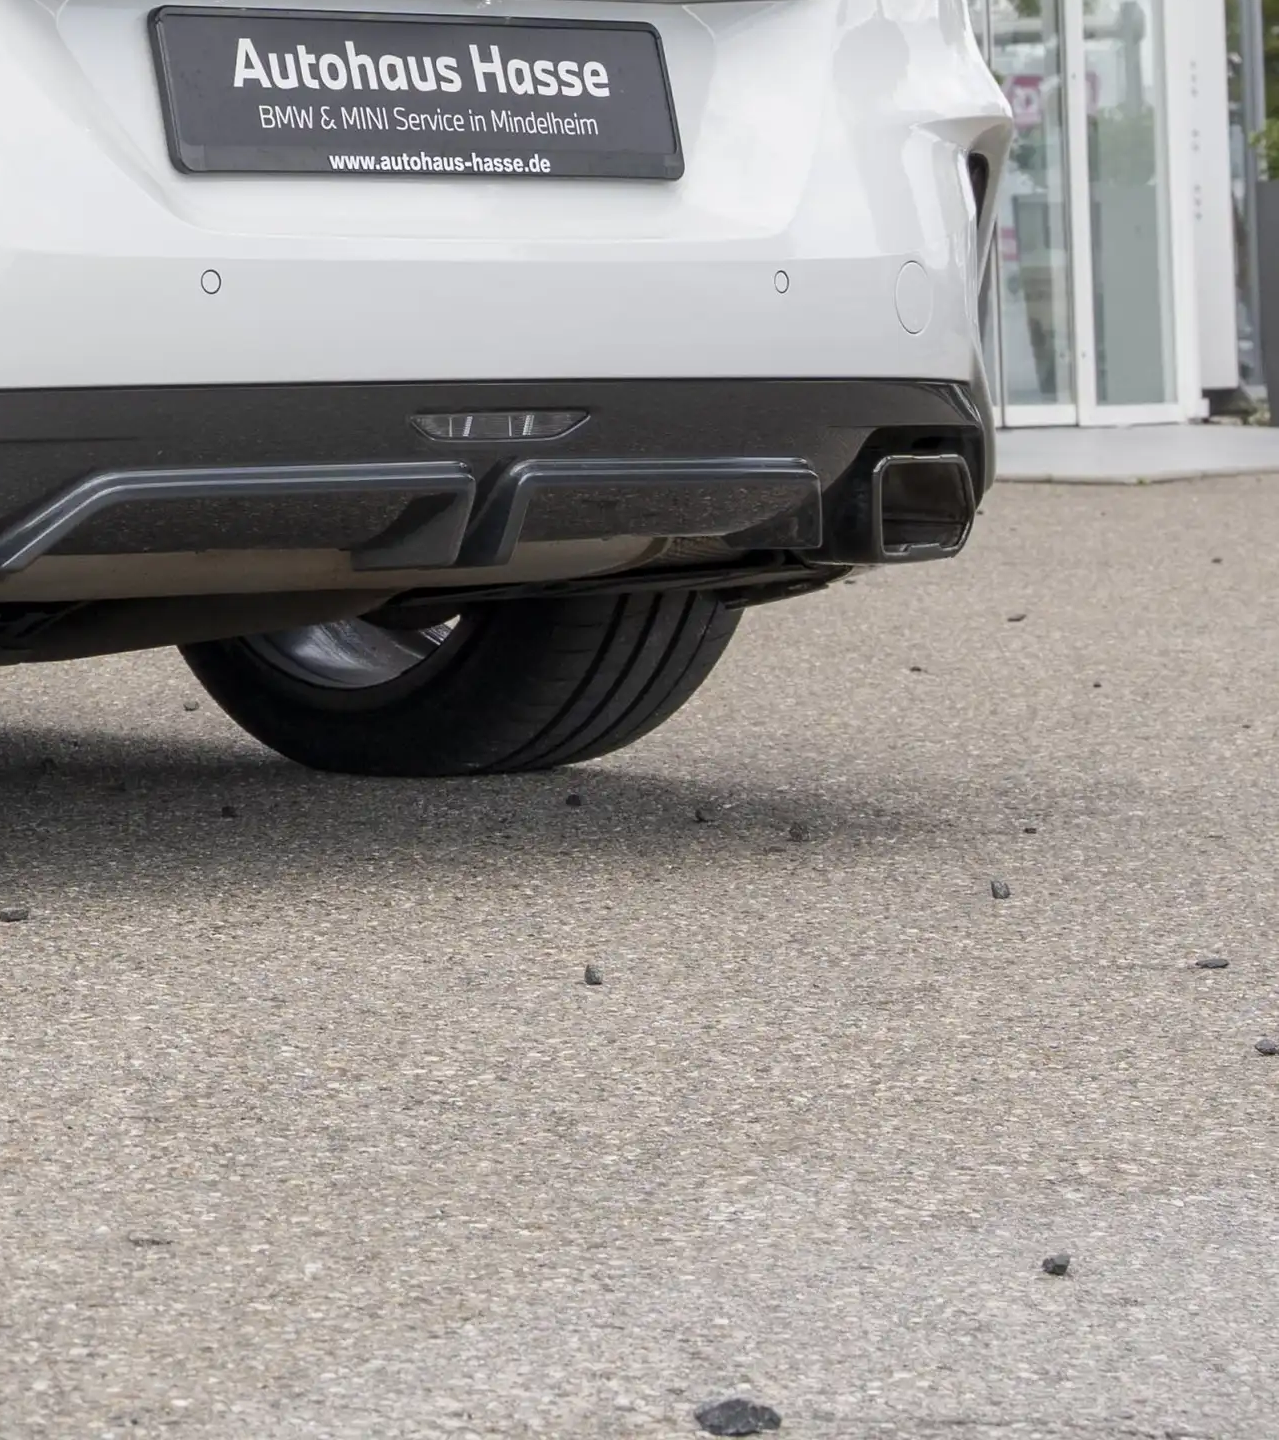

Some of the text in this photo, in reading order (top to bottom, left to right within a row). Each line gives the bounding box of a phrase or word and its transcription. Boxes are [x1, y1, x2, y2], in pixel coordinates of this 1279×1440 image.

[233, 38, 610, 97] Autohaus Hasse
[258, 105, 599, 135] BMW & MINI Service in Mindelheim
[329, 152, 551, 173] www.autohaus-hasse.de
